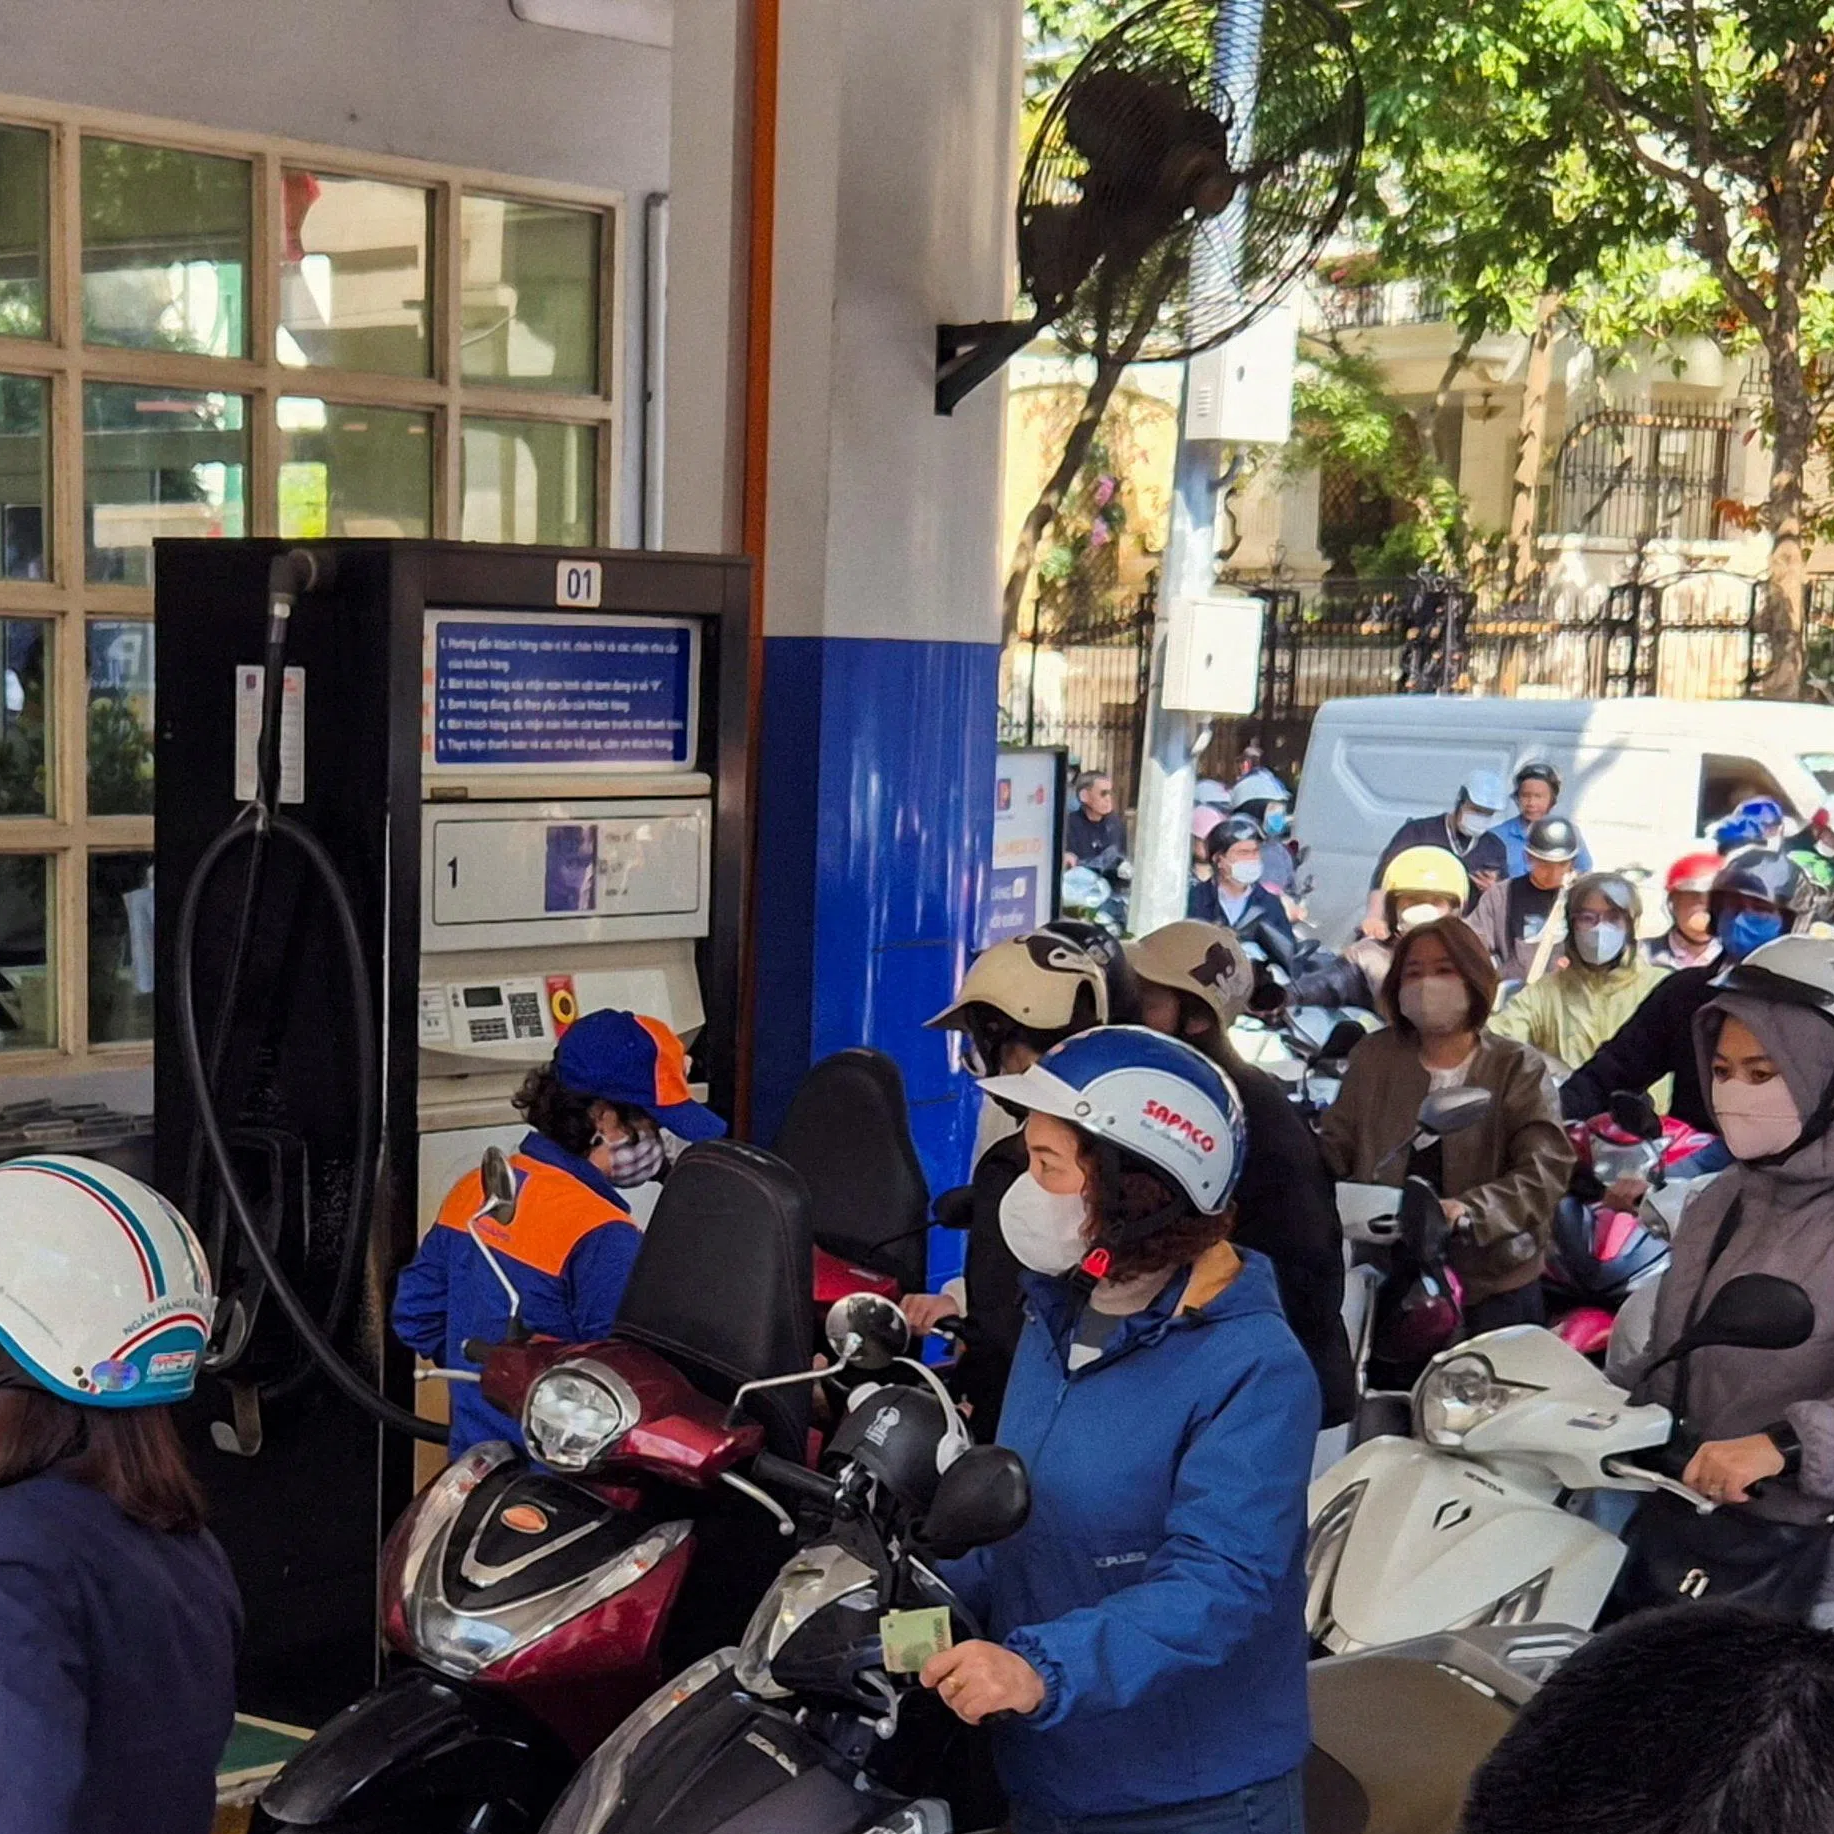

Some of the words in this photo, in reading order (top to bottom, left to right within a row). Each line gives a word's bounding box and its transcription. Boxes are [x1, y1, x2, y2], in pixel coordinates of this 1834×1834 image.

[567, 568, 593, 599] 01
[447, 857, 457, 889] 1
[1143, 1099, 1214, 1152] SAPACO
